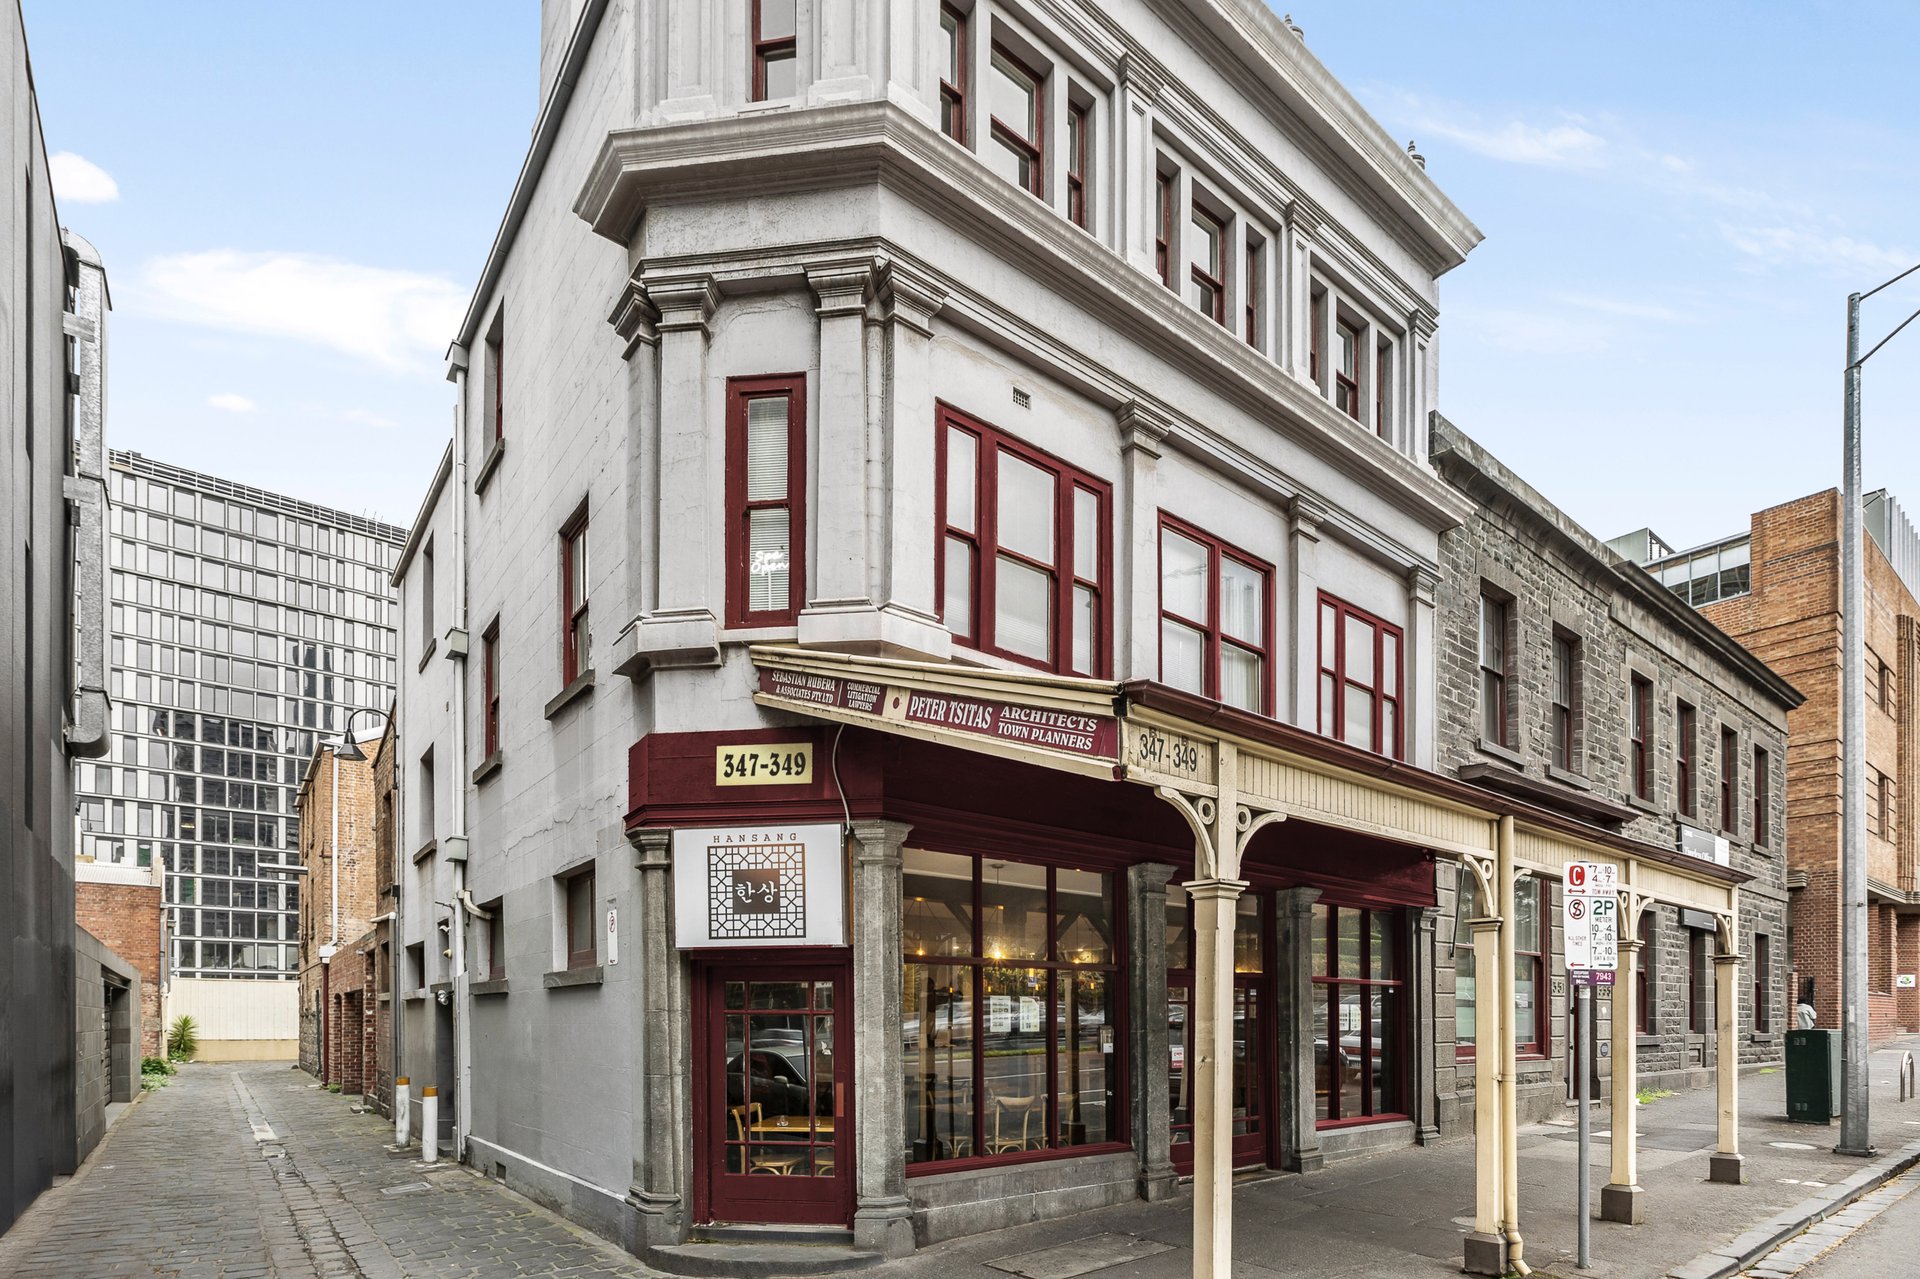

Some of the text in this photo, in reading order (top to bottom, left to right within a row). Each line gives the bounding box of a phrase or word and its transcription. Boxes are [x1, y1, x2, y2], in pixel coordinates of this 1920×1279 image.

[771, 670, 835, 691] SEBASTIAN RUBERA
[847, 682, 881, 694] COMMERCIAL
[775, 684, 834, 704] & ASSOCIATES PTY LTD
[847, 690, 878, 703] LITIGATION
[848, 699, 873, 711] LAWYERS
[909, 695, 993, 729] PETER TSITAS
[1000, 706, 1098, 732] ARCHITECTS
[997, 722, 1094, 750] TOWN PLANNERS
[723, 752, 806, 778] 347-349
[713, 833, 797, 844] HANSANG
[735, 881, 778, 904] 한상
[1593, 900, 1614, 916] 2P
[1596, 972, 1612, 981] 7943
